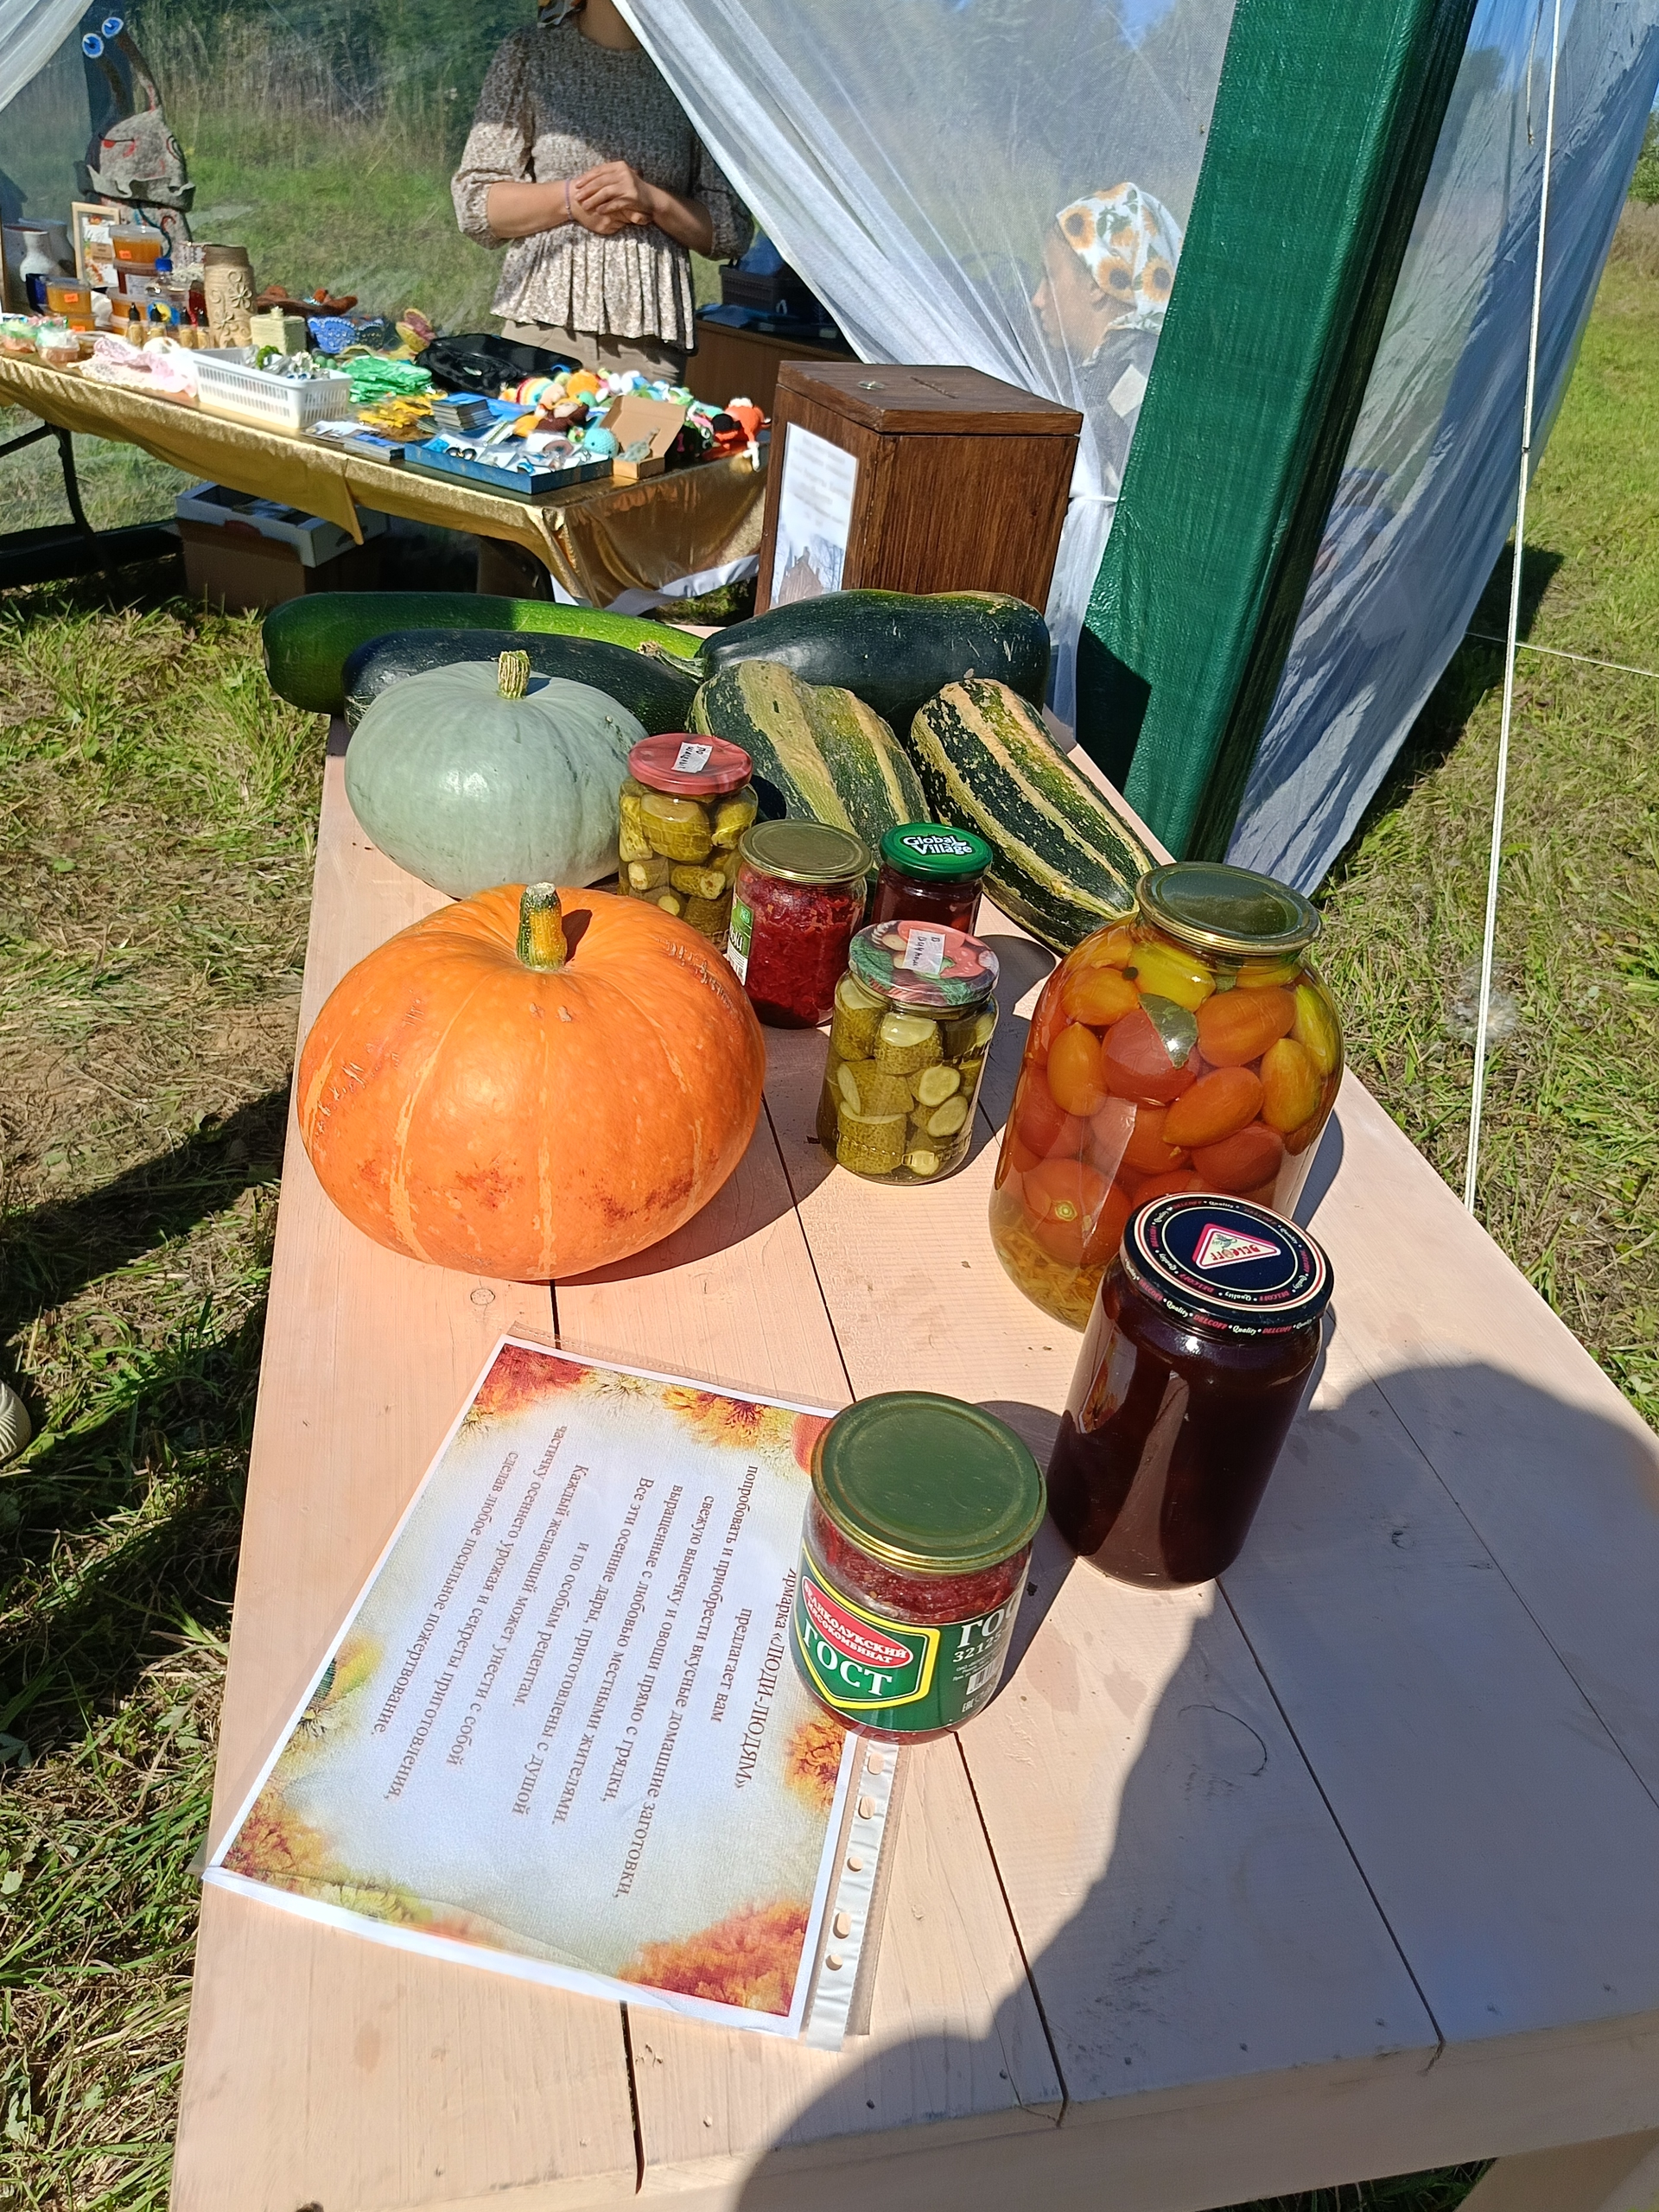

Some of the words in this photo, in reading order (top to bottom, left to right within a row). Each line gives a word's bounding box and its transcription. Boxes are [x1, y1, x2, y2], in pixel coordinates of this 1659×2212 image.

[903, 836, 967, 846] Global
[912, 842, 973, 855] Village
[1166, 1300, 1189, 1318] Quality
[1193, 1313, 1228, 1330] DELCOFF
[1232, 1325, 1257, 1336] Quality
[1262, 1325, 1293, 1334] DELCOFF
[492, 1451, 519, 1492] сделав
[532, 1426, 568, 1480] частичку
[470, 1493, 499, 1536] любое
[507, 1481, 542, 1539] осеннего
[555, 1464, 589, 1516] Каждый
[624, 1503, 641, 1526] эти
[633, 1477, 655, 1502] Все
[725, 1465, 759, 1544] попробовать
[576, 1541, 589, 1553] и
[645, 1484, 683, 1568] выращенные
[690, 1495, 715, 1545] свежую
[433, 1537, 477, 1611] посильное
[482, 1539, 515, 1592] урожая
[521, 1518, 563, 1593] желающий
[569, 1554, 585, 1571] по
[602, 1529, 632, 1583] осенние
[641, 1570, 653, 1579] с
[666, 1548, 697, 1606] выпечку
[721, 1547, 734, 1557] и
[476, 1594, 490, 1605] и
[499, 1595, 529, 1643] может
[544, 1573, 576, 1629] особым
[582, 1583, 609, 1624] дары,
[616, 1580, 649, 1648] любовью
[664, 1608, 677, 1619] и
[696, 1560, 730, 1642] приобрести
[447, 1607, 484, 1669] секреты
[647, 1621, 673, 1671] овощи
[720, 1608, 753, 1690] предлагает
[803, 1618, 893, 1696] ГОСТ
[807, 1599, 893, 1664] МЯСОКОМБИНАТ
[371, 1612, 441, 1735] пожертвование.
[474, 1643, 507, 1700] унести
[512, 1630, 552, 1707] рецептам.
[541, 1628, 594, 1738] приготовлены
[586, 1650, 625, 1730] местными
[675, 1644, 704, 1707] вкусные
[469, 1702, 482, 1713] с
[630, 1674, 656, 1722] прямо
[710, 1693, 729, 1723] вам
[734, 1632, 785, 1789] «ЛЮДИ-ЛЮДЯМ»
[383, 1671, 454, 1800] приготовления,
[446, 1715, 476, 1765] собой
[537, 1742, 550, 1751] с
[626, 1726, 639, 1736] с
[646, 1709, 683, 1798] домашние
[512, 1753, 544, 1815] душой
[551, 1732, 595, 1826] жителями.
[599, 1738, 634, 1802] грядки,
[612, 1802, 656, 1898] заготовки,
